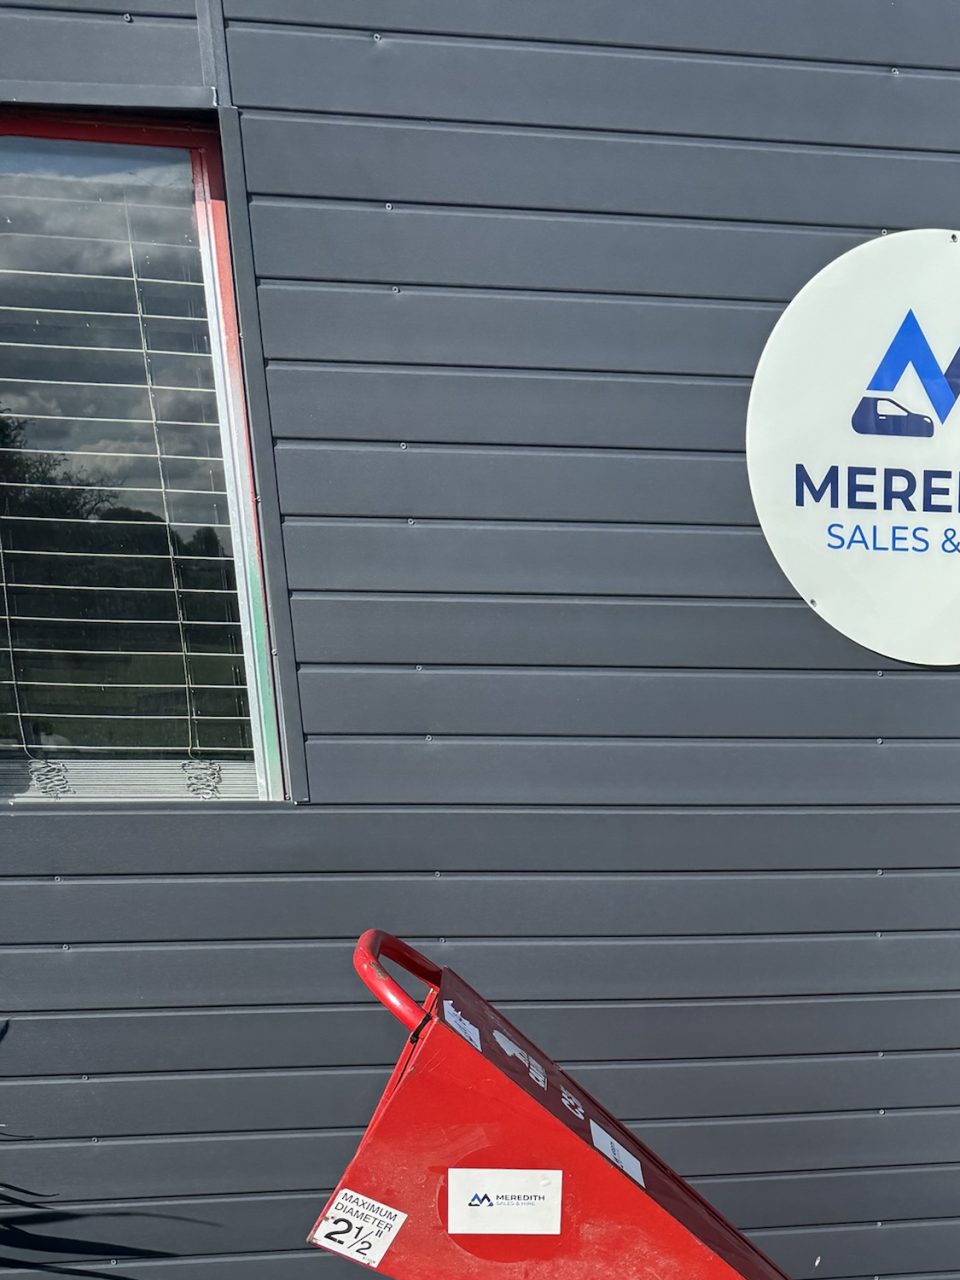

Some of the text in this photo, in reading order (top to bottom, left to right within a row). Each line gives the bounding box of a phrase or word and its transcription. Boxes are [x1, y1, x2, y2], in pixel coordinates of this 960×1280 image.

[827, 523, 930, 553] SALES
[334, 1201, 393, 1232] DIAMETER
[341, 1192, 398, 1222] MAXIMUM
